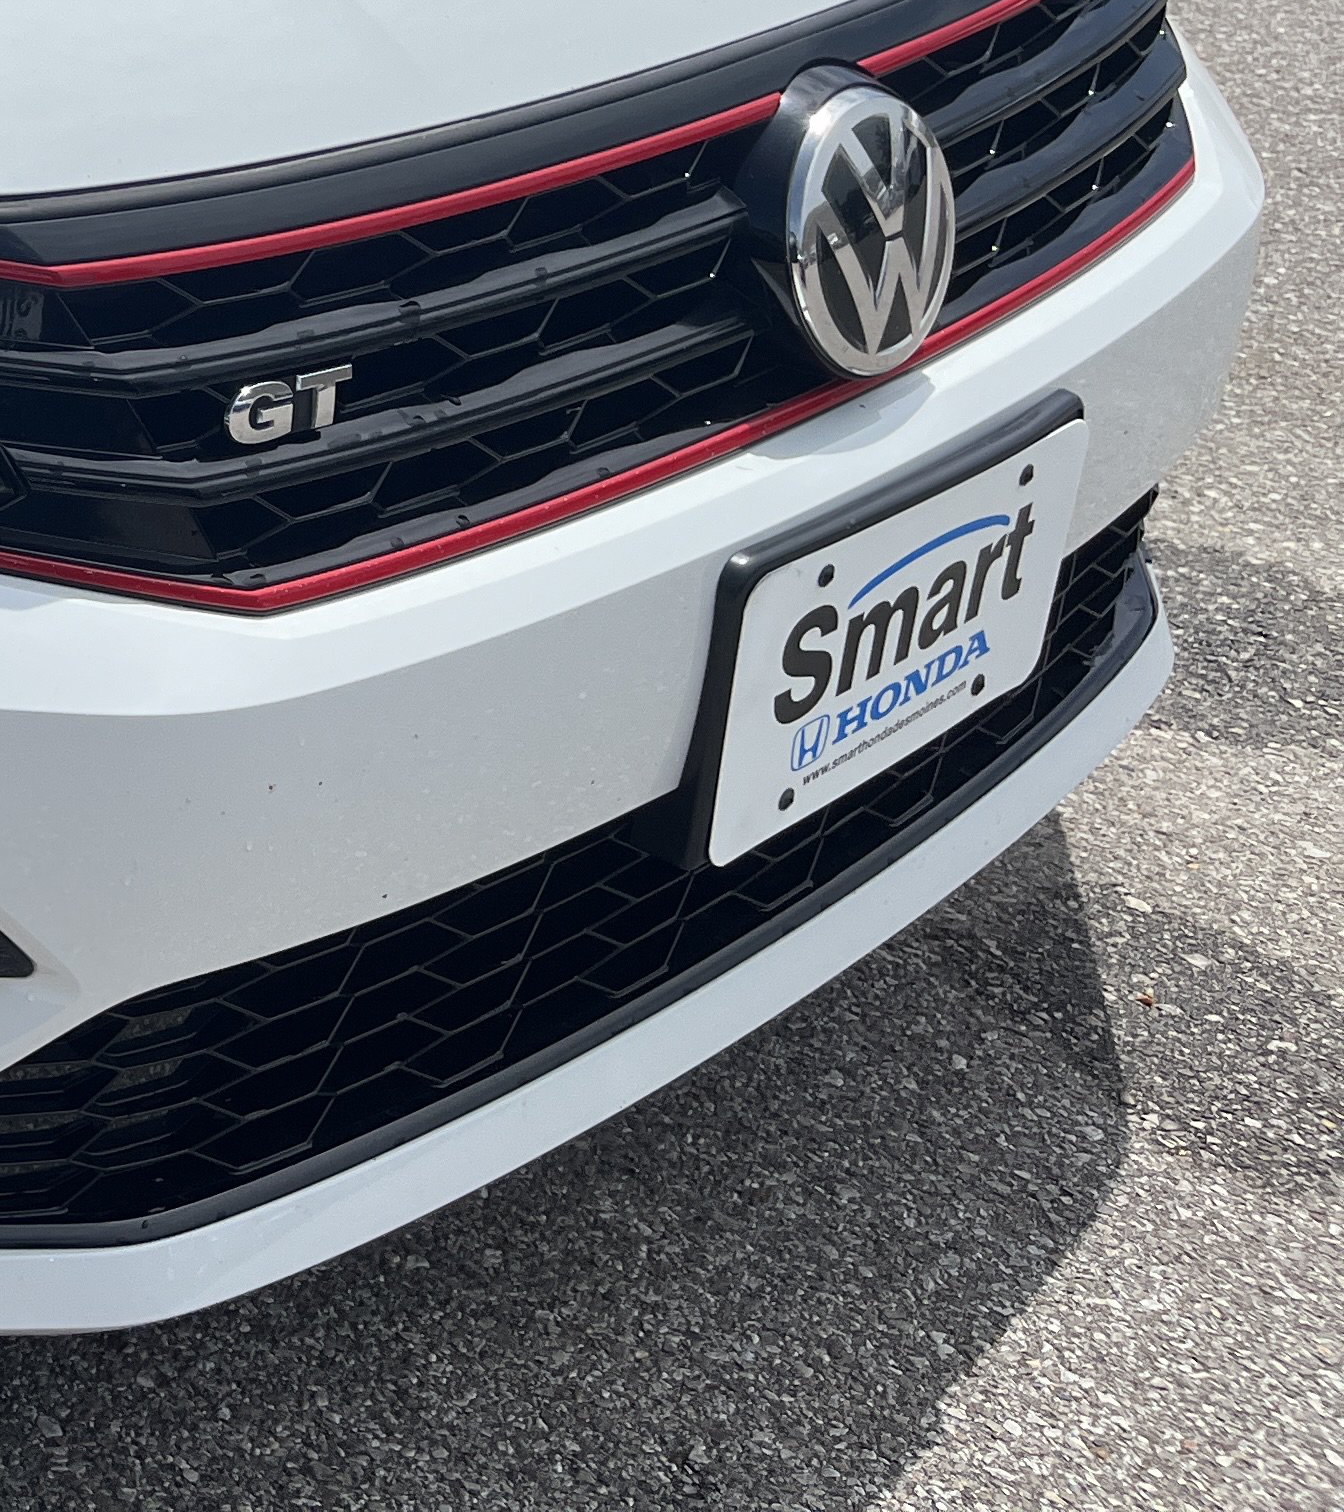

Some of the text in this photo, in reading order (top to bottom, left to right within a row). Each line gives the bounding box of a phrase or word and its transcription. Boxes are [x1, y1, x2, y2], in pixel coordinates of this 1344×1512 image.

[790, 90, 954, 372] VW
[224, 363, 353, 445] GT
[774, 503, 1035, 725] Smart
[802, 680, 967, 786] www.smarthondadesmoines.com
[832, 630, 990, 745] HONDA
